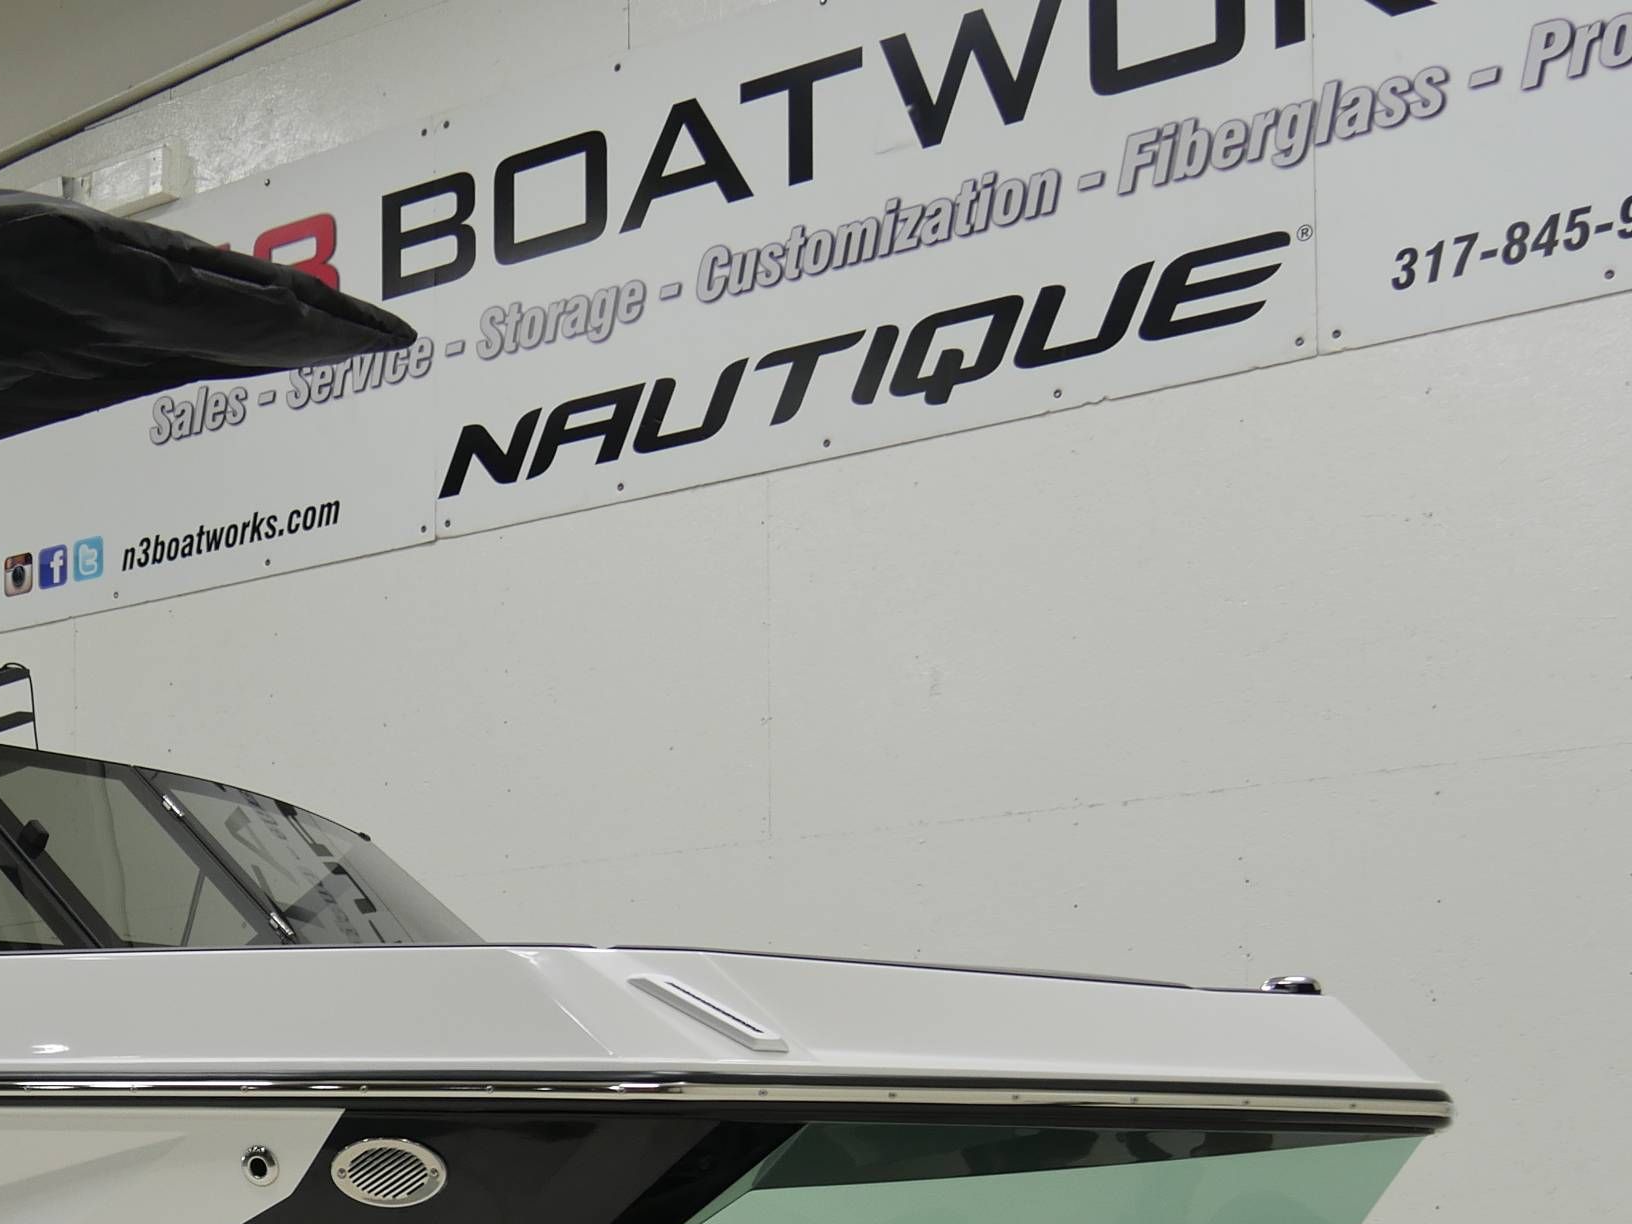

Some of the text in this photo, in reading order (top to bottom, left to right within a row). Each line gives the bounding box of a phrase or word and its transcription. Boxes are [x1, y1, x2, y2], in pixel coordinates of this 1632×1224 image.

[149, 387, 248, 446] Sales
[286, 336, 435, 411] Service
[476, 279, 646, 362] Storage
[696, 166, 1062, 305] Customization
[1117, 64, 1450, 197] Fiberglass
[438, 230, 1293, 500] NAUTIQUE
[121, 498, 342, 573] n3boatworks.com
